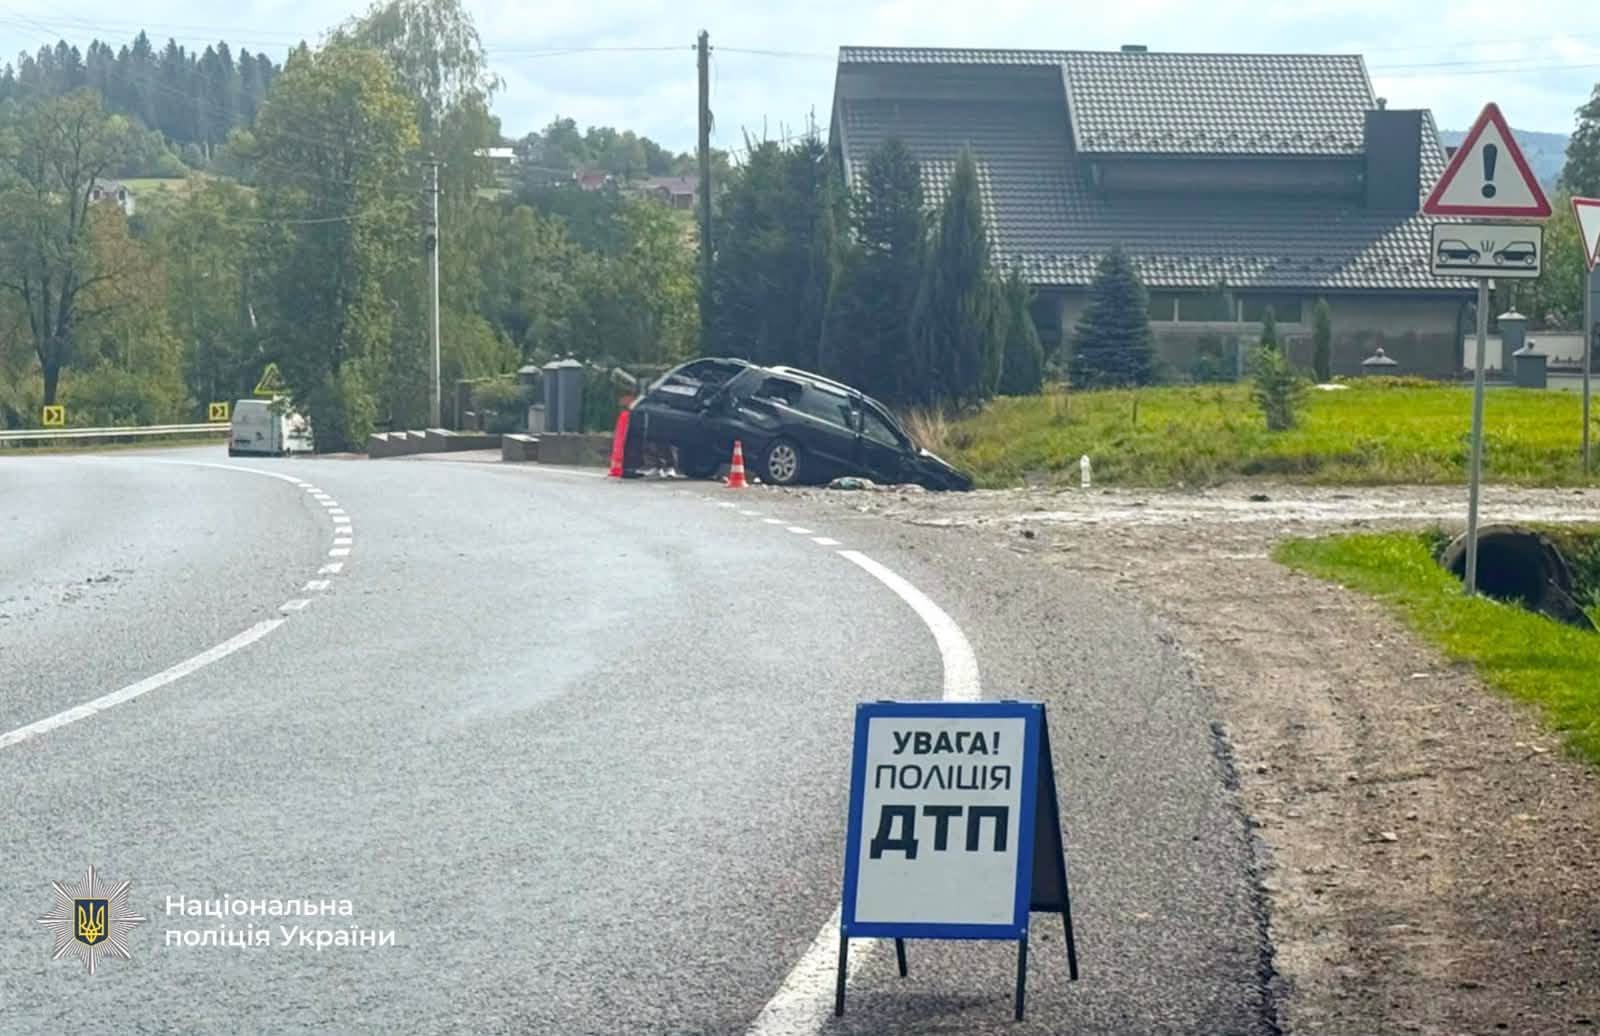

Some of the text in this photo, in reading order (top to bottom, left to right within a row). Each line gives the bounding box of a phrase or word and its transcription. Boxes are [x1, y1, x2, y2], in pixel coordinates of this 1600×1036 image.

[892, 731, 1001, 755] УВАГА!
[874, 764, 1011, 790] ПОЛІЦІЯ
[869, 804, 1009, 860] ДТП
